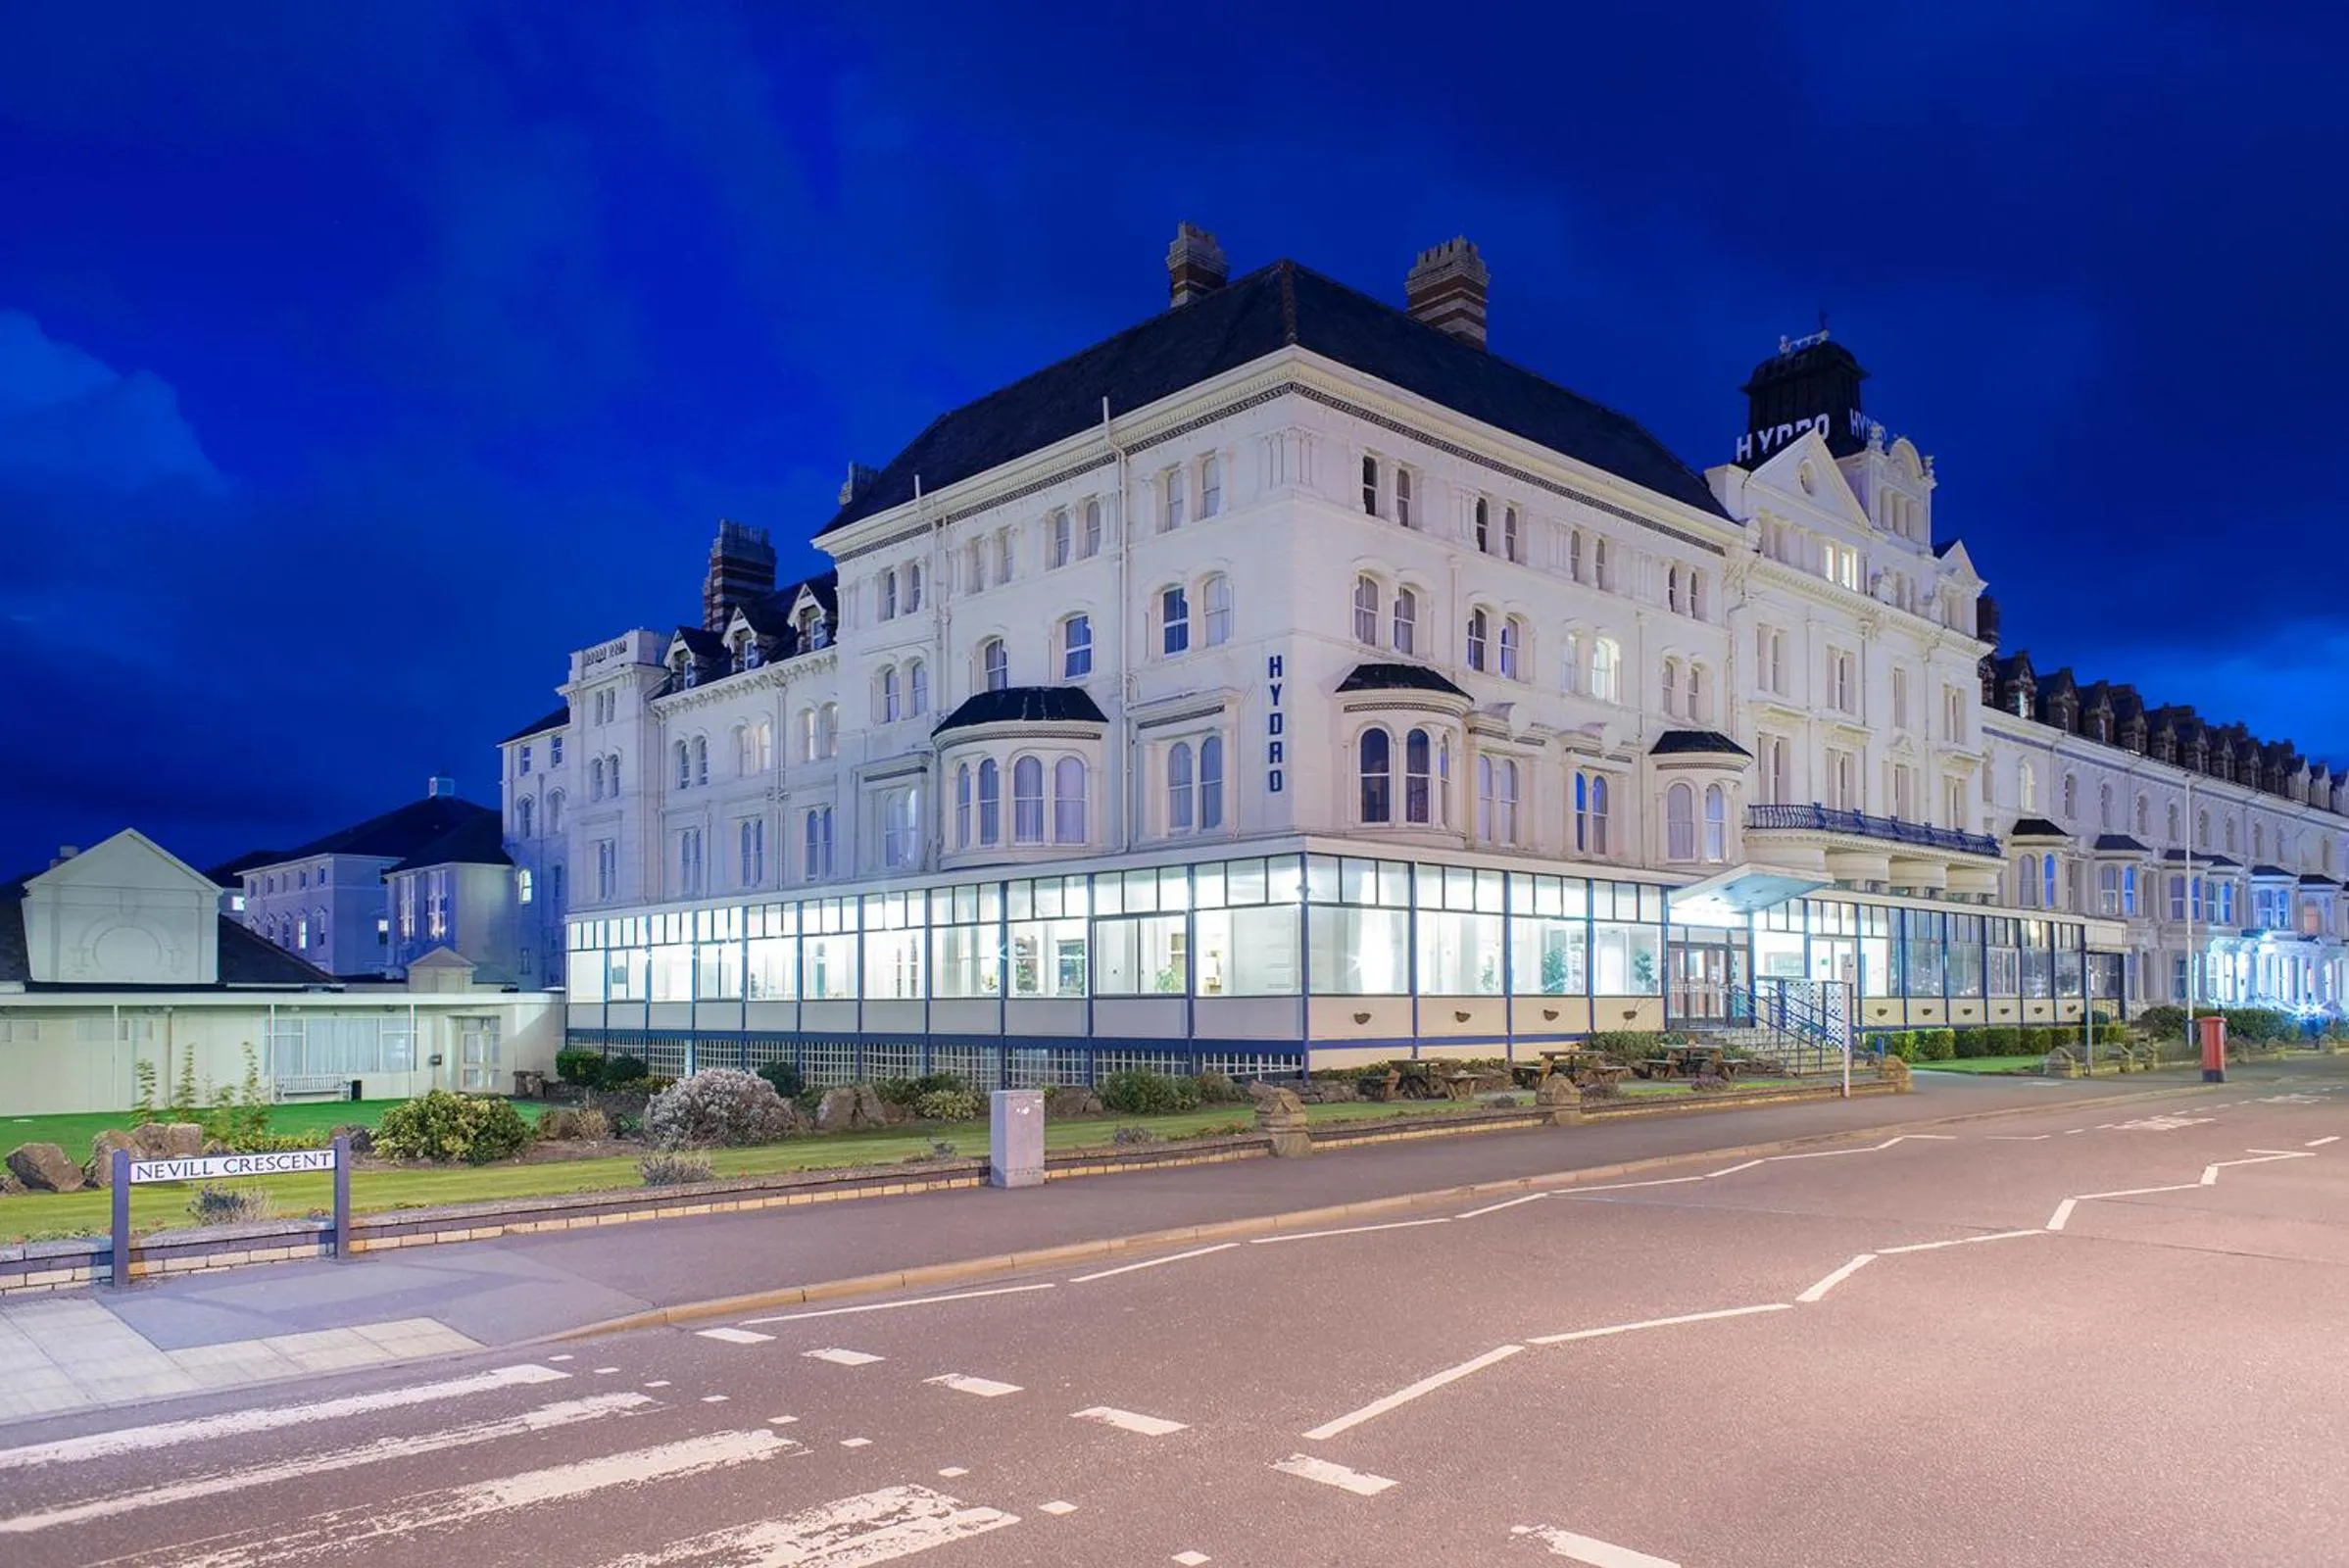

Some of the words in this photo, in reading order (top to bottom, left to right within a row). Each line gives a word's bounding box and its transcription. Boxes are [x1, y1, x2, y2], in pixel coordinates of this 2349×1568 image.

[1849, 408, 1887, 441] HYDO
[1269, 655, 1283, 792] HYDRO
[136, 1161, 214, 1180] NEVILL
[223, 1152, 331, 1174] CRESCENT
